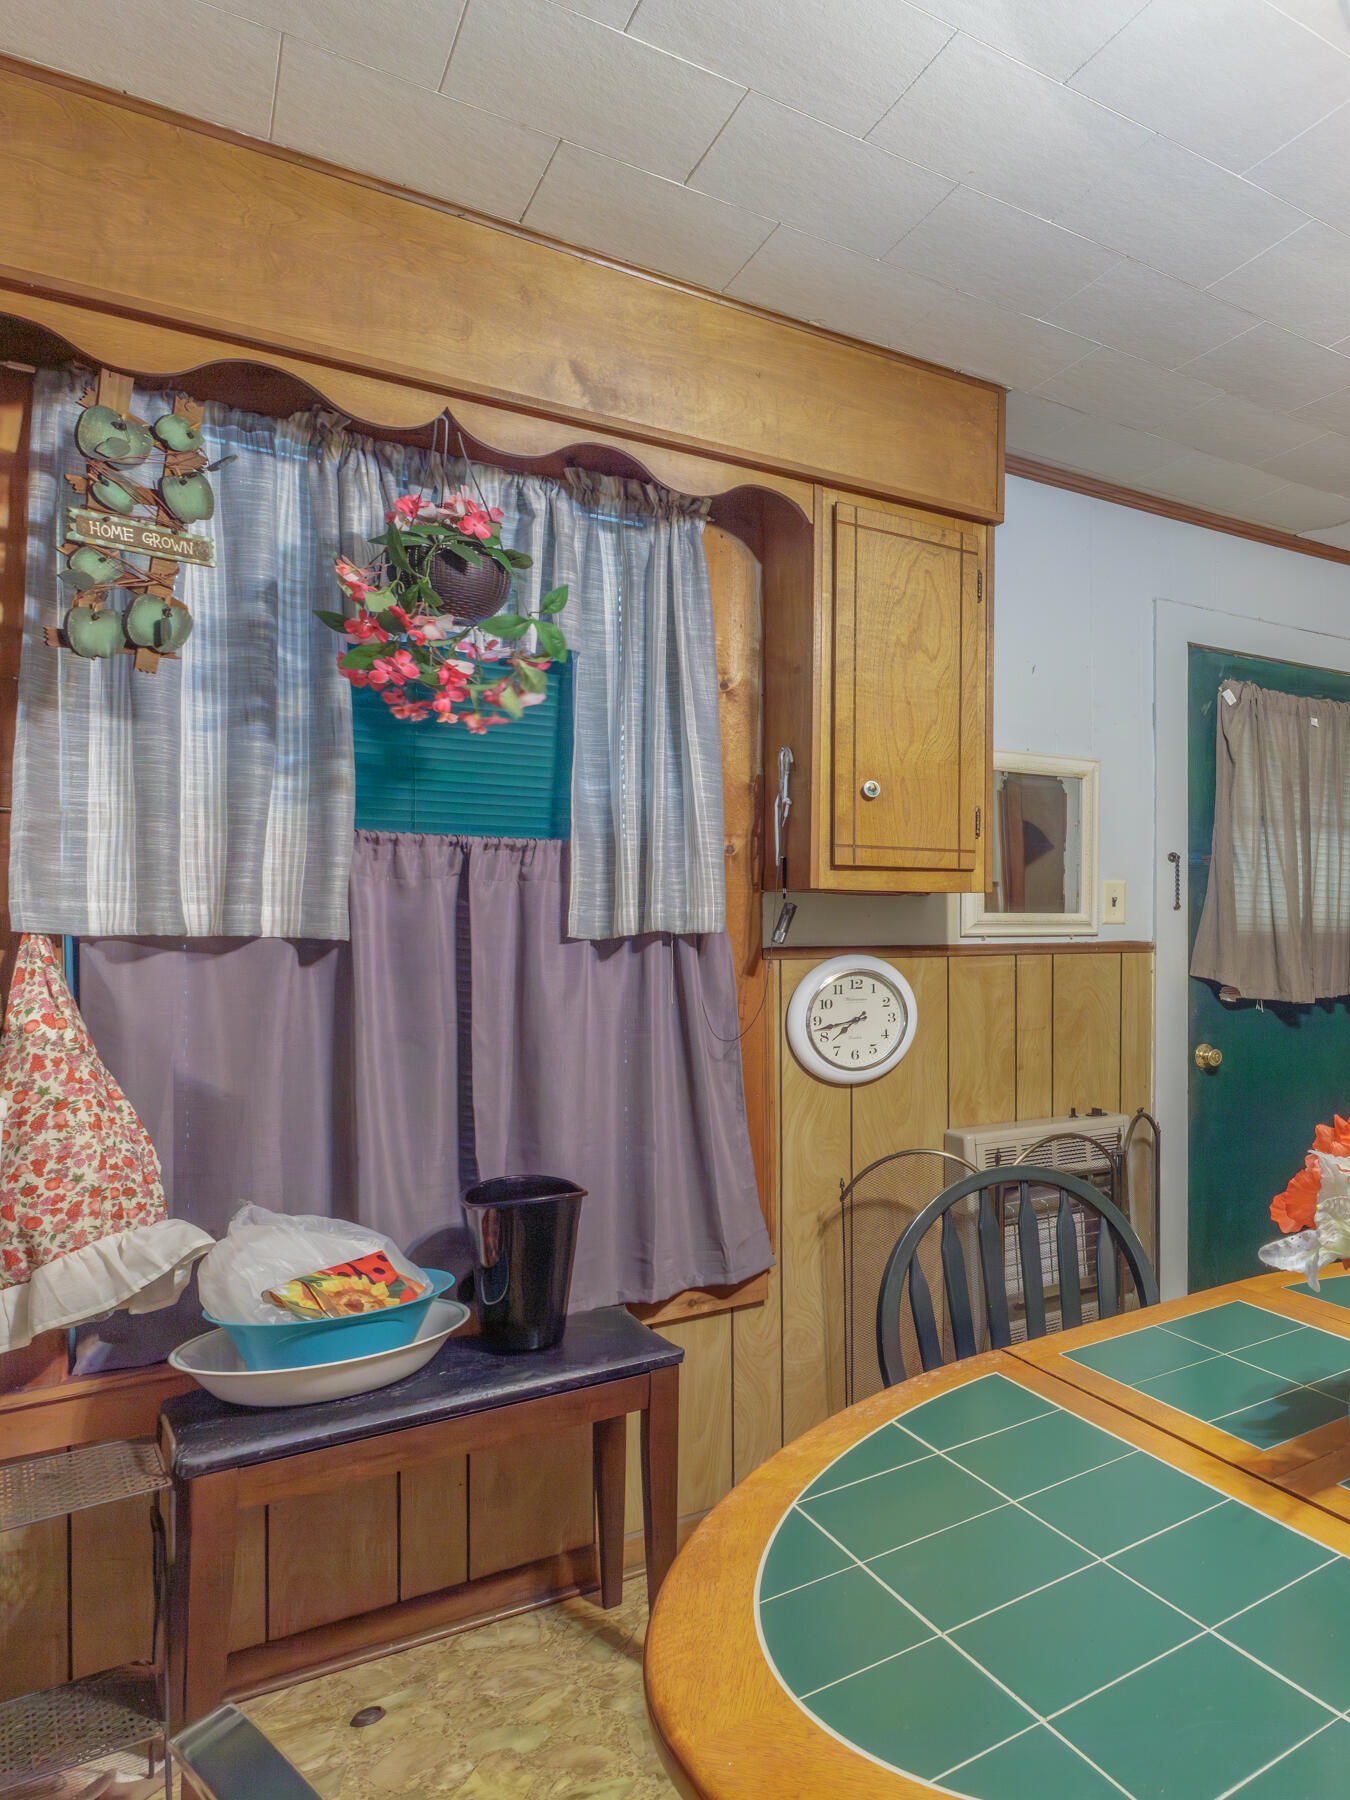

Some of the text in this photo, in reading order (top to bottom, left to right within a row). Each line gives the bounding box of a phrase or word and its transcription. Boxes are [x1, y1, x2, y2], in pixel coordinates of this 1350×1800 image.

[88, 520, 194, 555] HOME GROWN
[833, 984, 843, 994] 11
[850, 979, 863, 990] 12
[871, 984, 876, 994] 1
[820, 1000, 832, 1010] 10
[882, 997, 890, 1008] 2
[814, 1016, 822, 1026] 9
[888, 1012, 896, 1022] 3
[820, 1032, 829, 1042] 8
[881, 1028, 889, 1038] 4
[832, 1046, 840, 1056] 7
[868, 1044, 877, 1054] 5
[851, 1050, 860, 1060] 6
